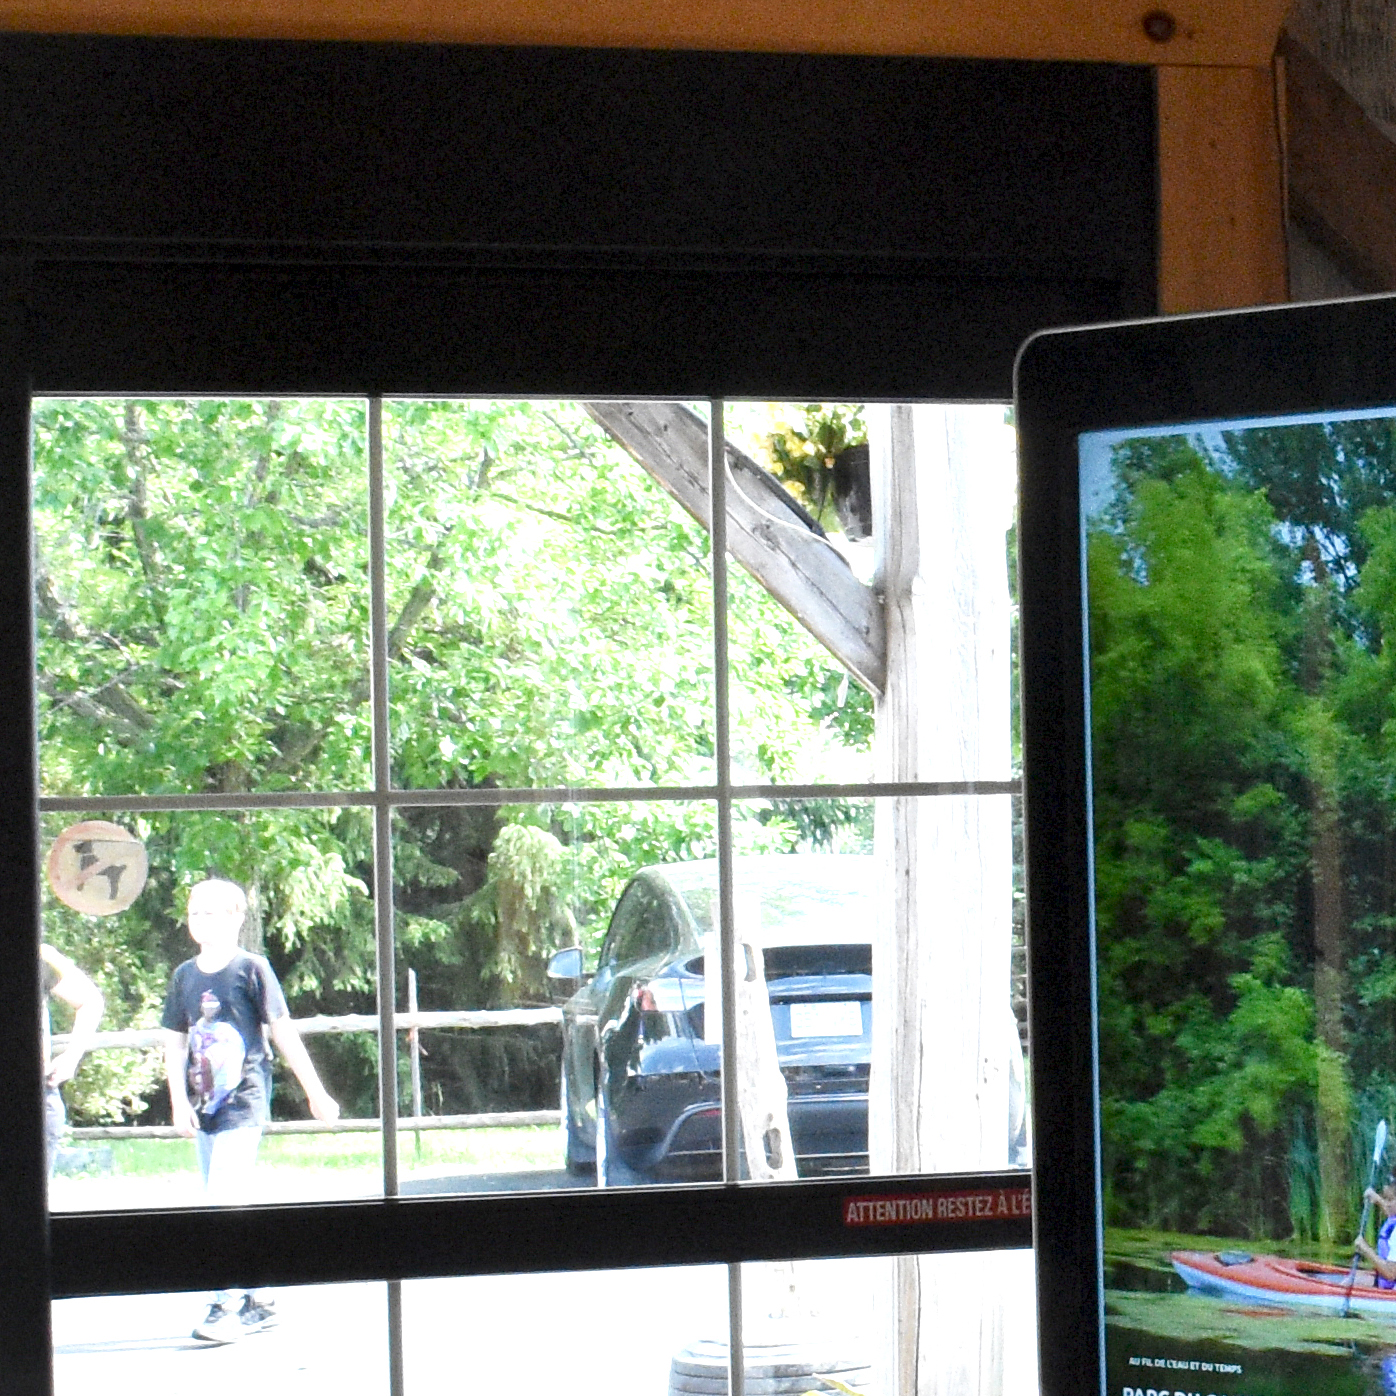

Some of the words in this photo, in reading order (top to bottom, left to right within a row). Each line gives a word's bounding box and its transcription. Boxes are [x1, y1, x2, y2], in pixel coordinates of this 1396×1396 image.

[847, 1199, 933, 1222] ATTENTION
[937, 1195, 992, 1218] RESTEZ
[997, 1190, 1008, 1215] À
[1129, 1357, 1140, 1366] AU
[1142, 1358, 1153, 1367] FIL
[1155, 1358, 1165, 1368] DE
[1167, 1359, 1188, 1369] L'EAU
[1190, 1361, 1200, 1370] ET
[1202, 1362, 1213, 1371] DU
[1215, 1363, 1242, 1374] TEMPS
